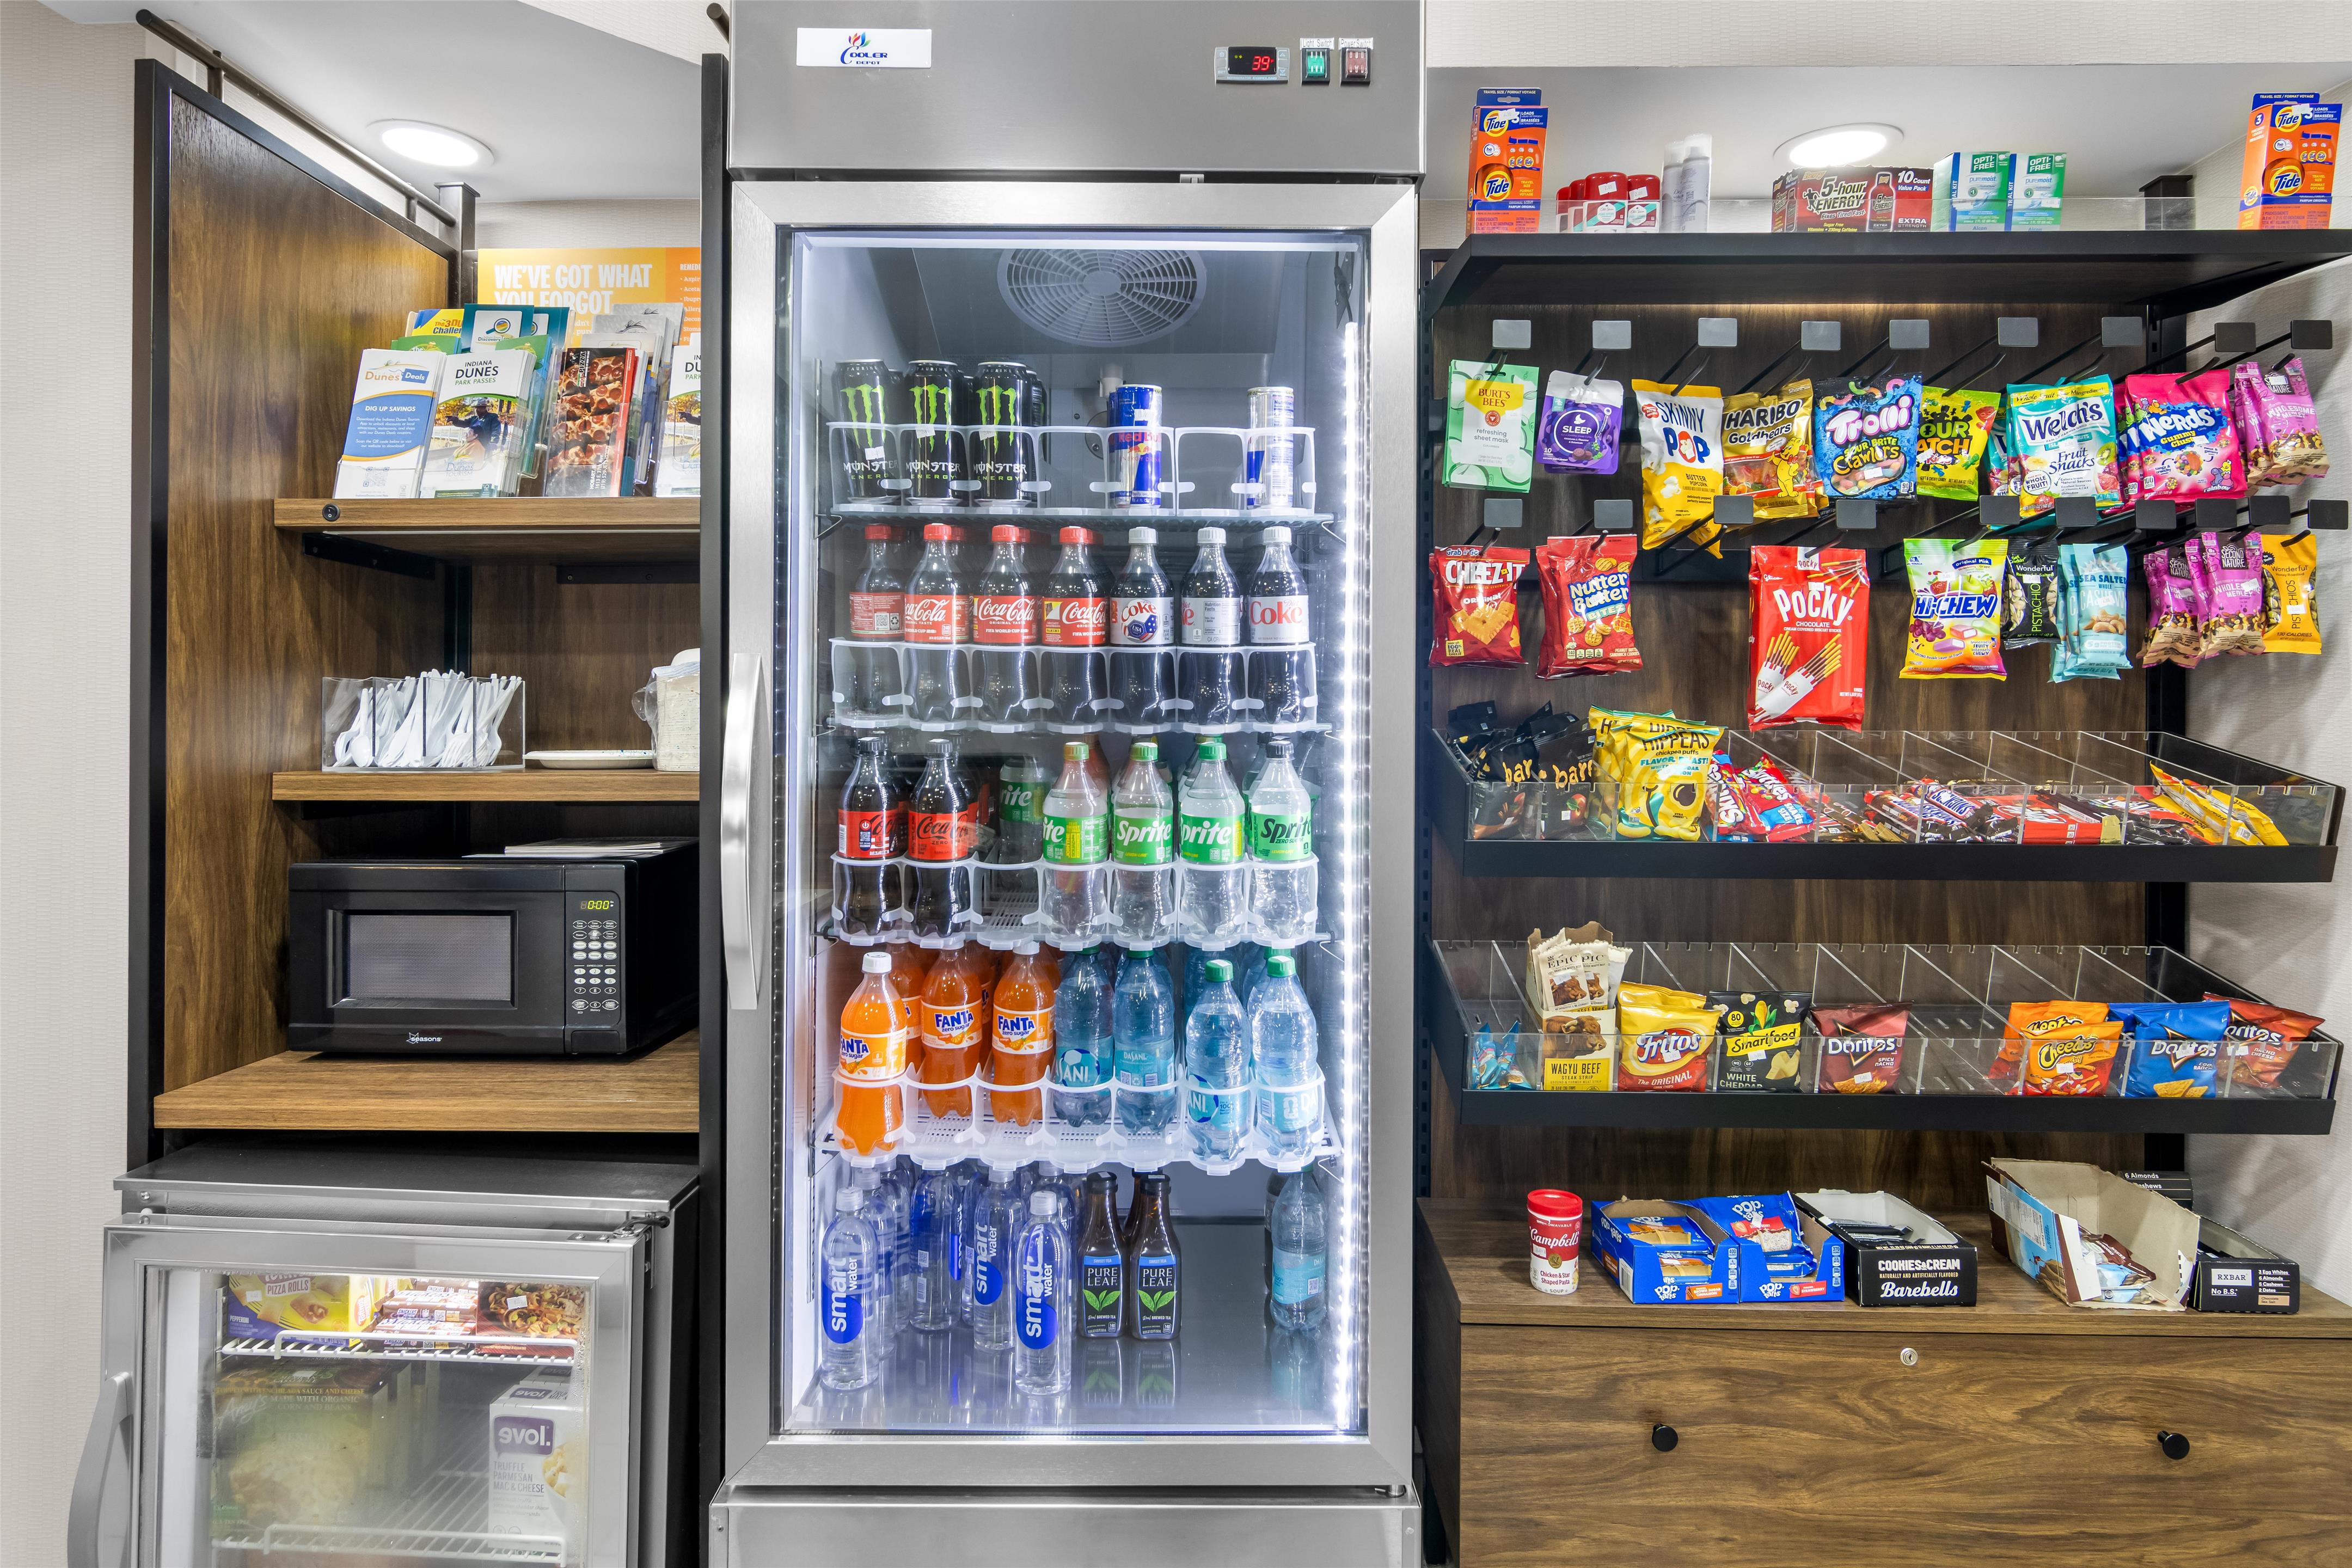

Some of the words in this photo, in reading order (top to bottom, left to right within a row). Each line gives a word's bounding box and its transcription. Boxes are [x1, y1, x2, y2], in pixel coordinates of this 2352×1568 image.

[1303, 39, 1314, 48] Light
[1317, 39, 1332, 47] Switch
[1341, 39, 1355, 48] Power
[1356, 39, 1371, 48] Switch
[841, 46, 887, 65] COOLER
[1252, 56, 1271, 70] 39
[1973, 156, 1995, 166] OPTI-
[1974, 162, 1996, 171] FREE
[1898, 170, 1914, 184] 10
[2275, 173, 2300, 193] Tide
[1486, 178, 1509, 197] Tide
[1822, 176, 1866, 197] 5-hour
[1817, 192, 1863, 211] ENERGY
[1821, 211, 1835, 219] Fixes
[494, 264, 551, 289] WE'VE
[555, 264, 592, 288] GOT
[598, 264, 652, 287] WHAT
[365, 371, 399, 381] Dunes
[456, 366, 499, 378] DUNES
[1479, 388, 1510, 399] BURT'S
[1483, 399, 1505, 407] BEES
[1724, 400, 1803, 430] HARIBO
[2267, 406, 2315, 418] WHOLESOME
[1828, 395, 1913, 444] Trolli
[2023, 402, 2103, 440] Welch's
[1477, 428, 1507, 437] refreshing
[1563, 425, 1592, 434] SLEEP
[1729, 423, 1791, 444] Goldbears
[2161, 430, 2196, 444] Gummy
[2058, 448, 2088, 462] Fruit
[844, 460, 898, 472] MONSTER
[906, 460, 960, 472] MONSTER
[973, 461, 1027, 474] MONSTER
[2049, 457, 2095, 475] Snacks
[1686, 474, 1706, 482] BUTTER
[2026, 476, 2046, 485] WHOLE
[2027, 481, 2048, 490] FRUIT!
[2221, 549, 2244, 559] SECOND
[2016, 564, 2054, 572] Wonderful
[2222, 558, 2246, 568] NATURE
[2080, 574, 2097, 583] SEA
[1571, 573, 1627, 599] Nutter
[978, 598, 1035, 621] Coca-Cola
[1121, 602, 1156, 622] Coke
[1250, 601, 1302, 625] Coke
[1588, 604, 1625, 620] BITES
[1914, 595, 1997, 618] HI-CHEW
[1643, 732, 1709, 751] HIPPEAS
[1640, 758, 1675, 766] FLAVOR
[1117, 819, 1171, 846] Sprite
[1548, 955, 1578, 968] EPIC
[935, 1011, 973, 1027] FANTA
[955, 1022, 970, 1031] sugar
[1637, 1029, 1701, 1063] Fritos
[1731, 1030, 1797, 1054] Smartfood
[1828, 1038, 1896, 1055] Doritos
[1124, 1051, 1147, 1061] DASANI
[2041, 1038, 2097, 1069] Cheetos
[2251, 1052, 2274, 1060] CHEESE
[1551, 1063, 1578, 1075] WAGYU
[1582, 1062, 1601, 1074] BEEF
[1651, 1070, 1692, 1086] ORIGINAL
[1726, 1073, 1757, 1082] WHITE
[849, 1258, 858, 1291] water
[1088, 1267, 1118, 1277] PURE
[267, 1284, 286, 1295] PIZZA
[288, 1279, 309, 1292] ROLLS
[1088, 1277, 1117, 1286] LEAF
[829, 1257, 847, 1332] smart
[1881, 1281, 1958, 1298] Barebells
[494, 1461, 525, 1472] TRUFFLE
[494, 1472, 532, 1482] PARMESAN
[493, 1481, 510, 1491] MAC
[511, 1483, 516, 1491] &
[518, 1482, 544, 1493] CHEESE
